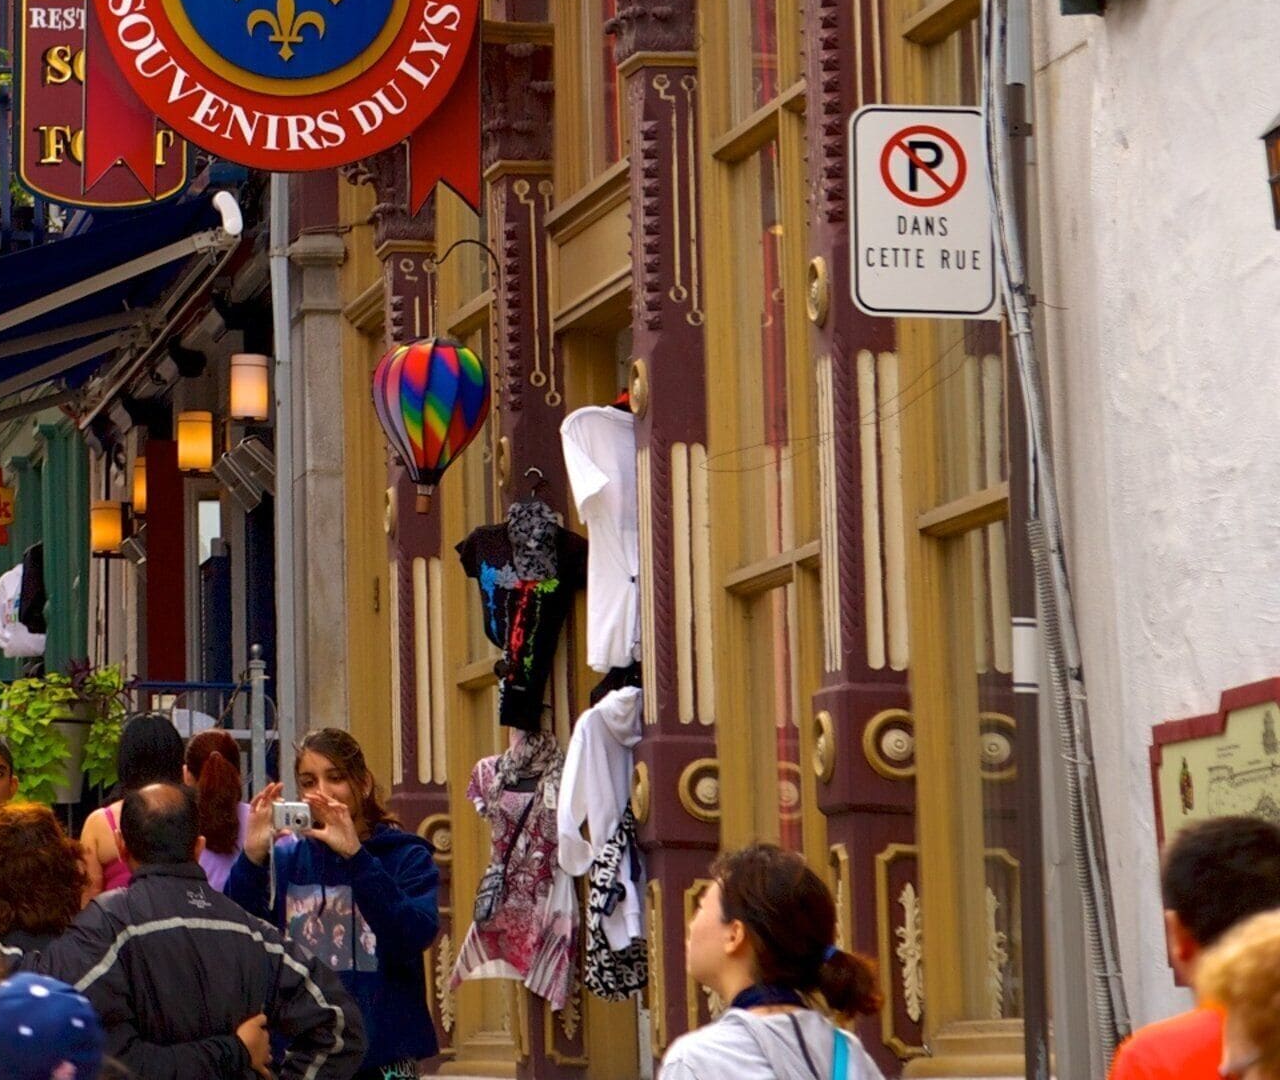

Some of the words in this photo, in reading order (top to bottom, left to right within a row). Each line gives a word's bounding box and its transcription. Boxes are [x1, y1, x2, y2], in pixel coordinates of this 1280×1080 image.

[348, 79, 409, 136] DU
[396, 0, 461, 90] LYS
[897, 215, 948, 237] DANS
[866, 247, 925, 269] CETTE
[940, 249, 981, 270] RUE
